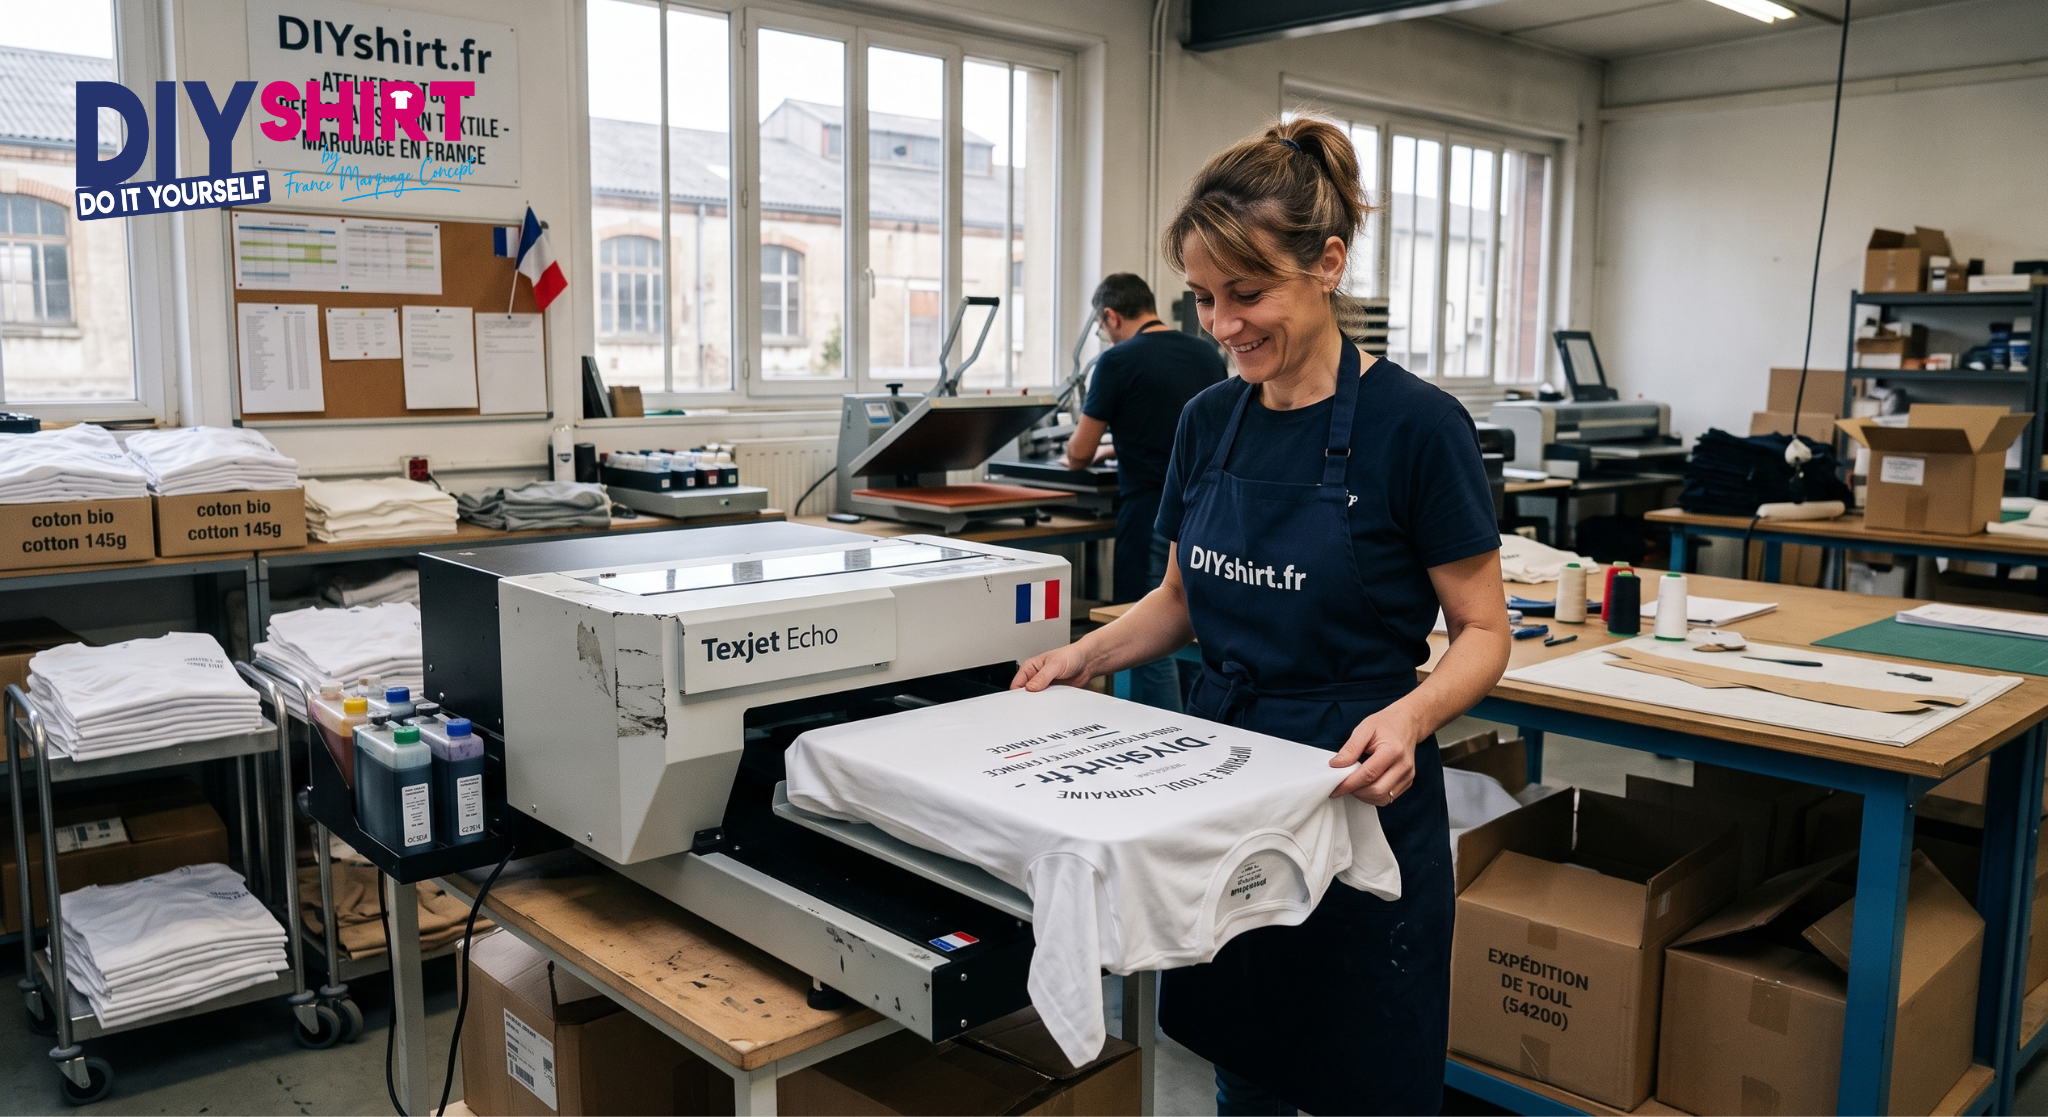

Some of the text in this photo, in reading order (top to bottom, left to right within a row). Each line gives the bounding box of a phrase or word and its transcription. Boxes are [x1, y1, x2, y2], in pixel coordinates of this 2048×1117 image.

[278, 15, 492, 74] DIYshirt.fr
[401, 138, 421, 160] EN
[426, 141, 486, 165] FRANCE
[32, 509, 114, 528] coton bio
[197, 499, 271, 517] coton bio
[22, 532, 127, 553] cotton 145g
[188, 522, 282, 541] cotton 145g
[1190, 545, 1307, 591] DIYshirt.fr
[701, 624, 839, 663] Texjet Echo
[1064, 723, 1107, 736] MADE
[1057, 787, 1156, 800] LORRAINE
[1488, 948, 1589, 991] EXPÉDITION
[1501, 973, 1573, 1009] DE TOUL
[1502, 995, 1569, 1032] (54200)
